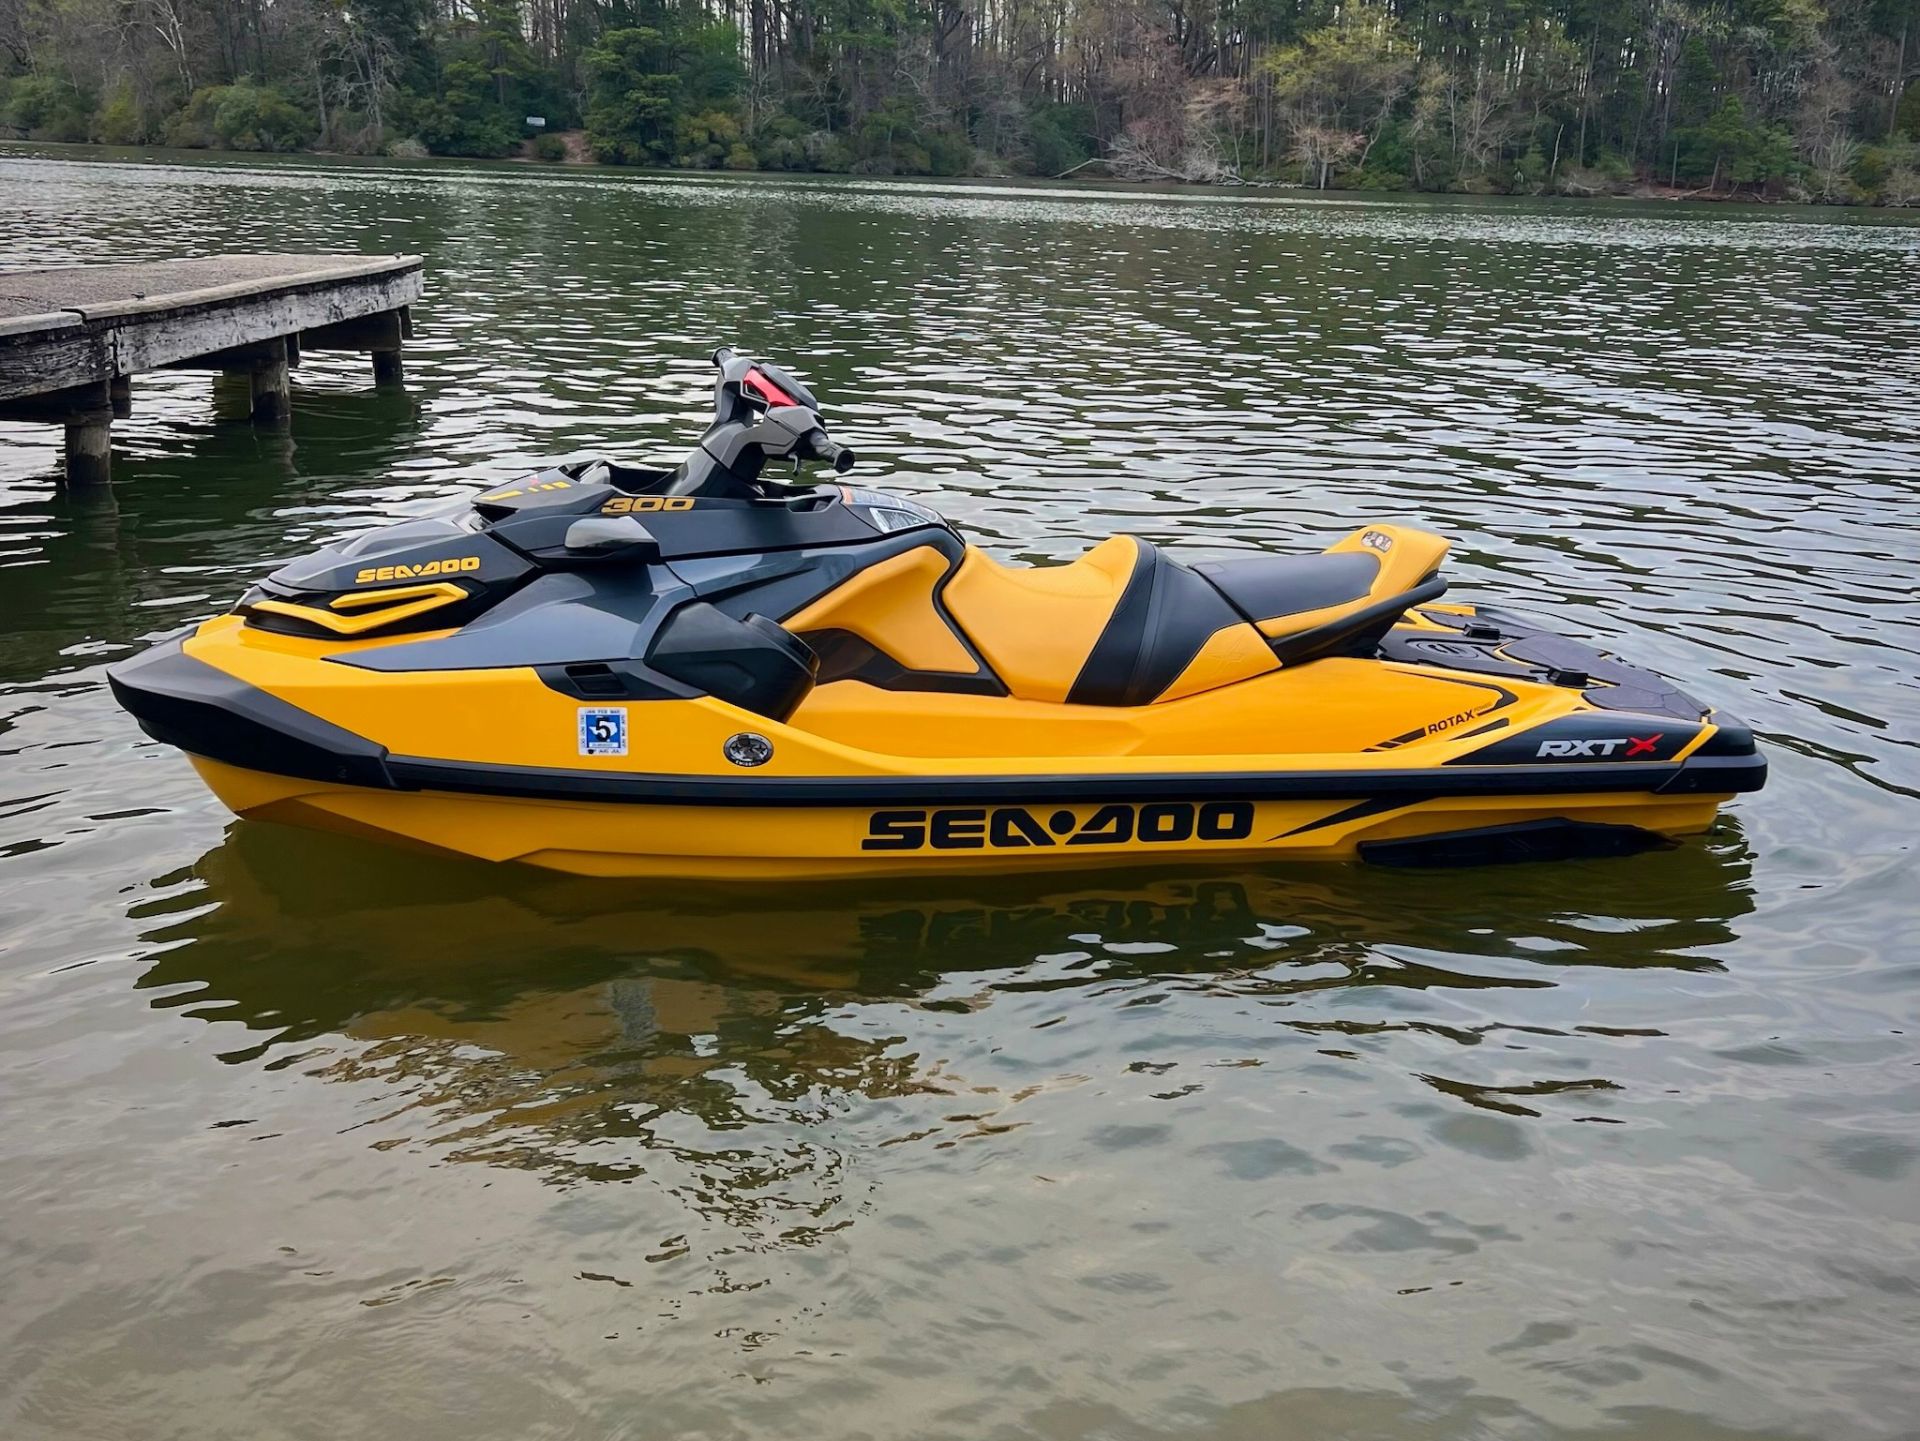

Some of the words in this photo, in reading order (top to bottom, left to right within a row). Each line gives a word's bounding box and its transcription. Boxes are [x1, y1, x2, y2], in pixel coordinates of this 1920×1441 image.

[601, 497, 695, 514] 300
[596, 716, 611, 742] 5
[1428, 709, 1475, 734] ROTAX
